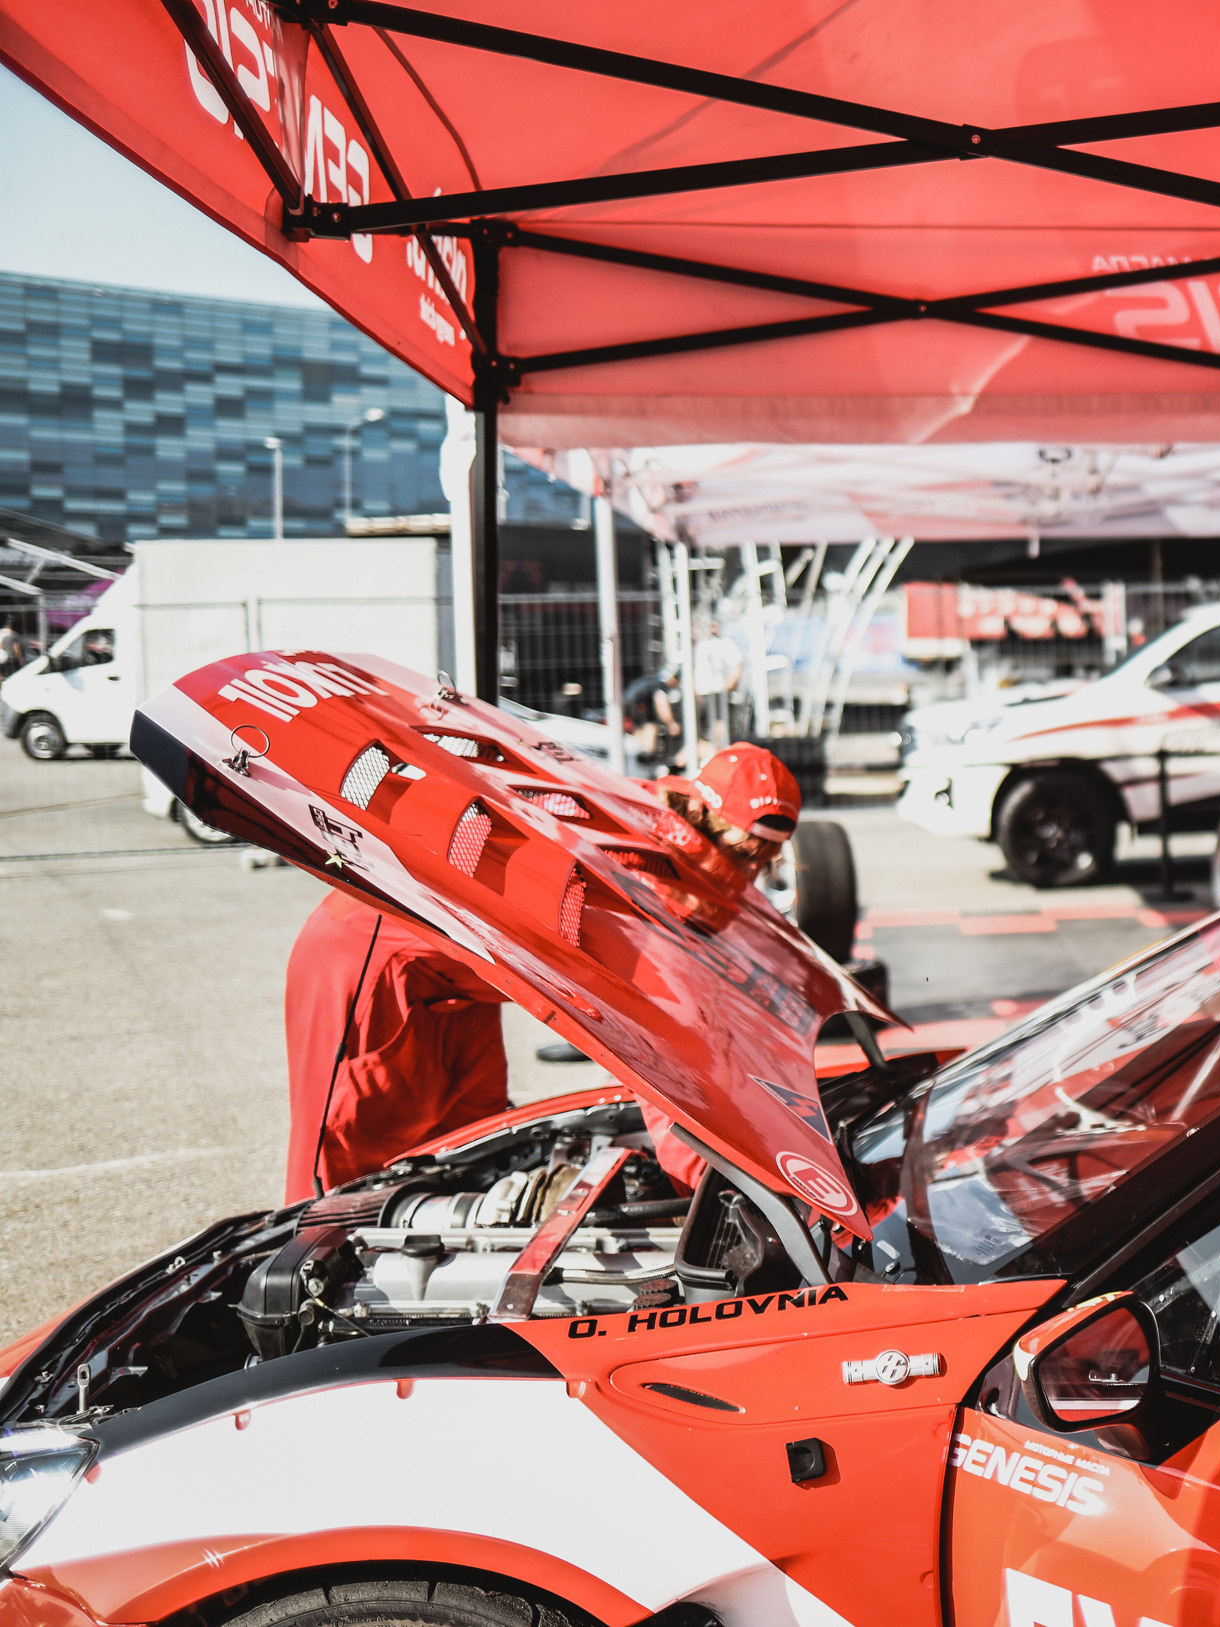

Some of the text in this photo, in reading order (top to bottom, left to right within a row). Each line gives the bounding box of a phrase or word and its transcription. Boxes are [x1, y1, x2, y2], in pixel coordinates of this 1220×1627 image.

[568, 1285, 849, 1339] O. HOLOVNIA
[948, 1433, 1107, 1516] GENESIS
